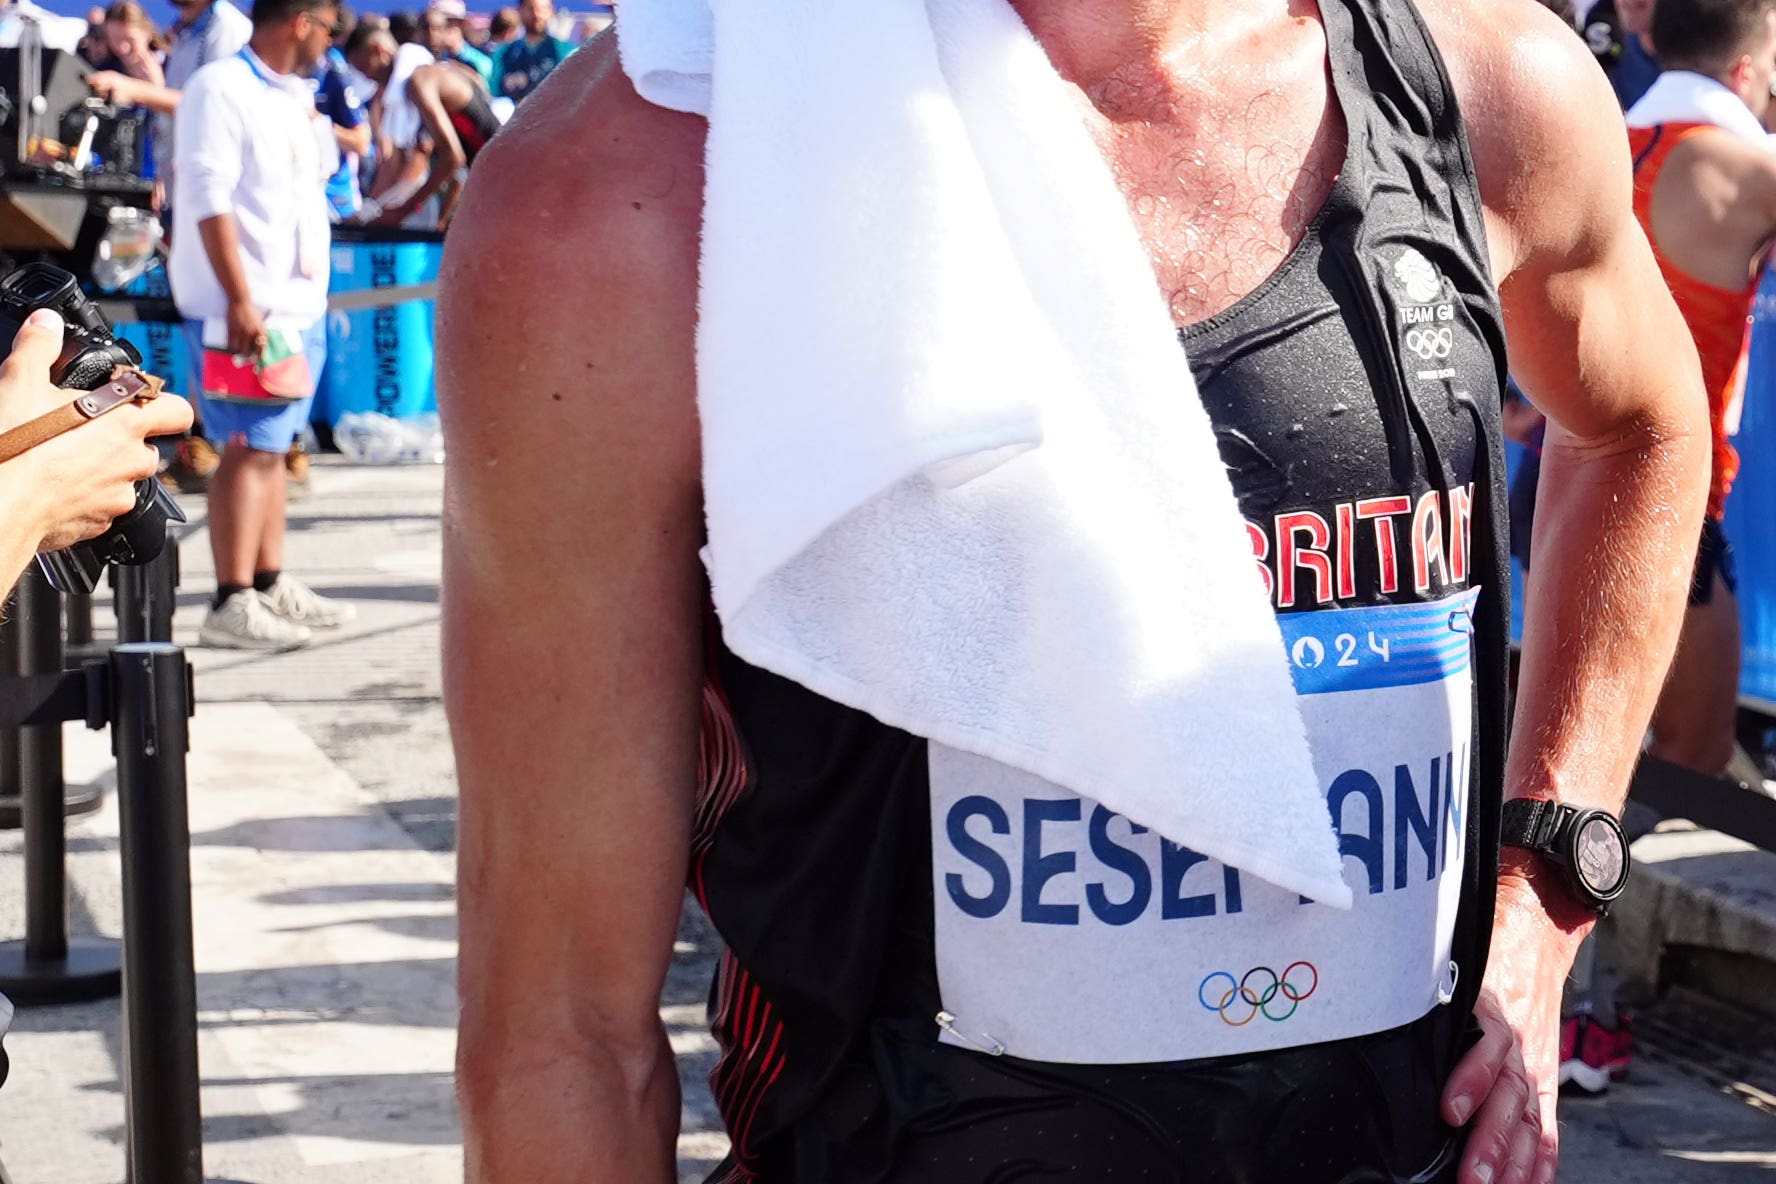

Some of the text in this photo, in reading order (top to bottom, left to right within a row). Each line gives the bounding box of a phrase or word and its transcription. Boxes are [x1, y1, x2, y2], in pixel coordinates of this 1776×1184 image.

[371, 247, 398, 418] POWERDE
[1400, 305, 1435, 324] TEAM
[944, 741, 1466, 926] SESEANN
